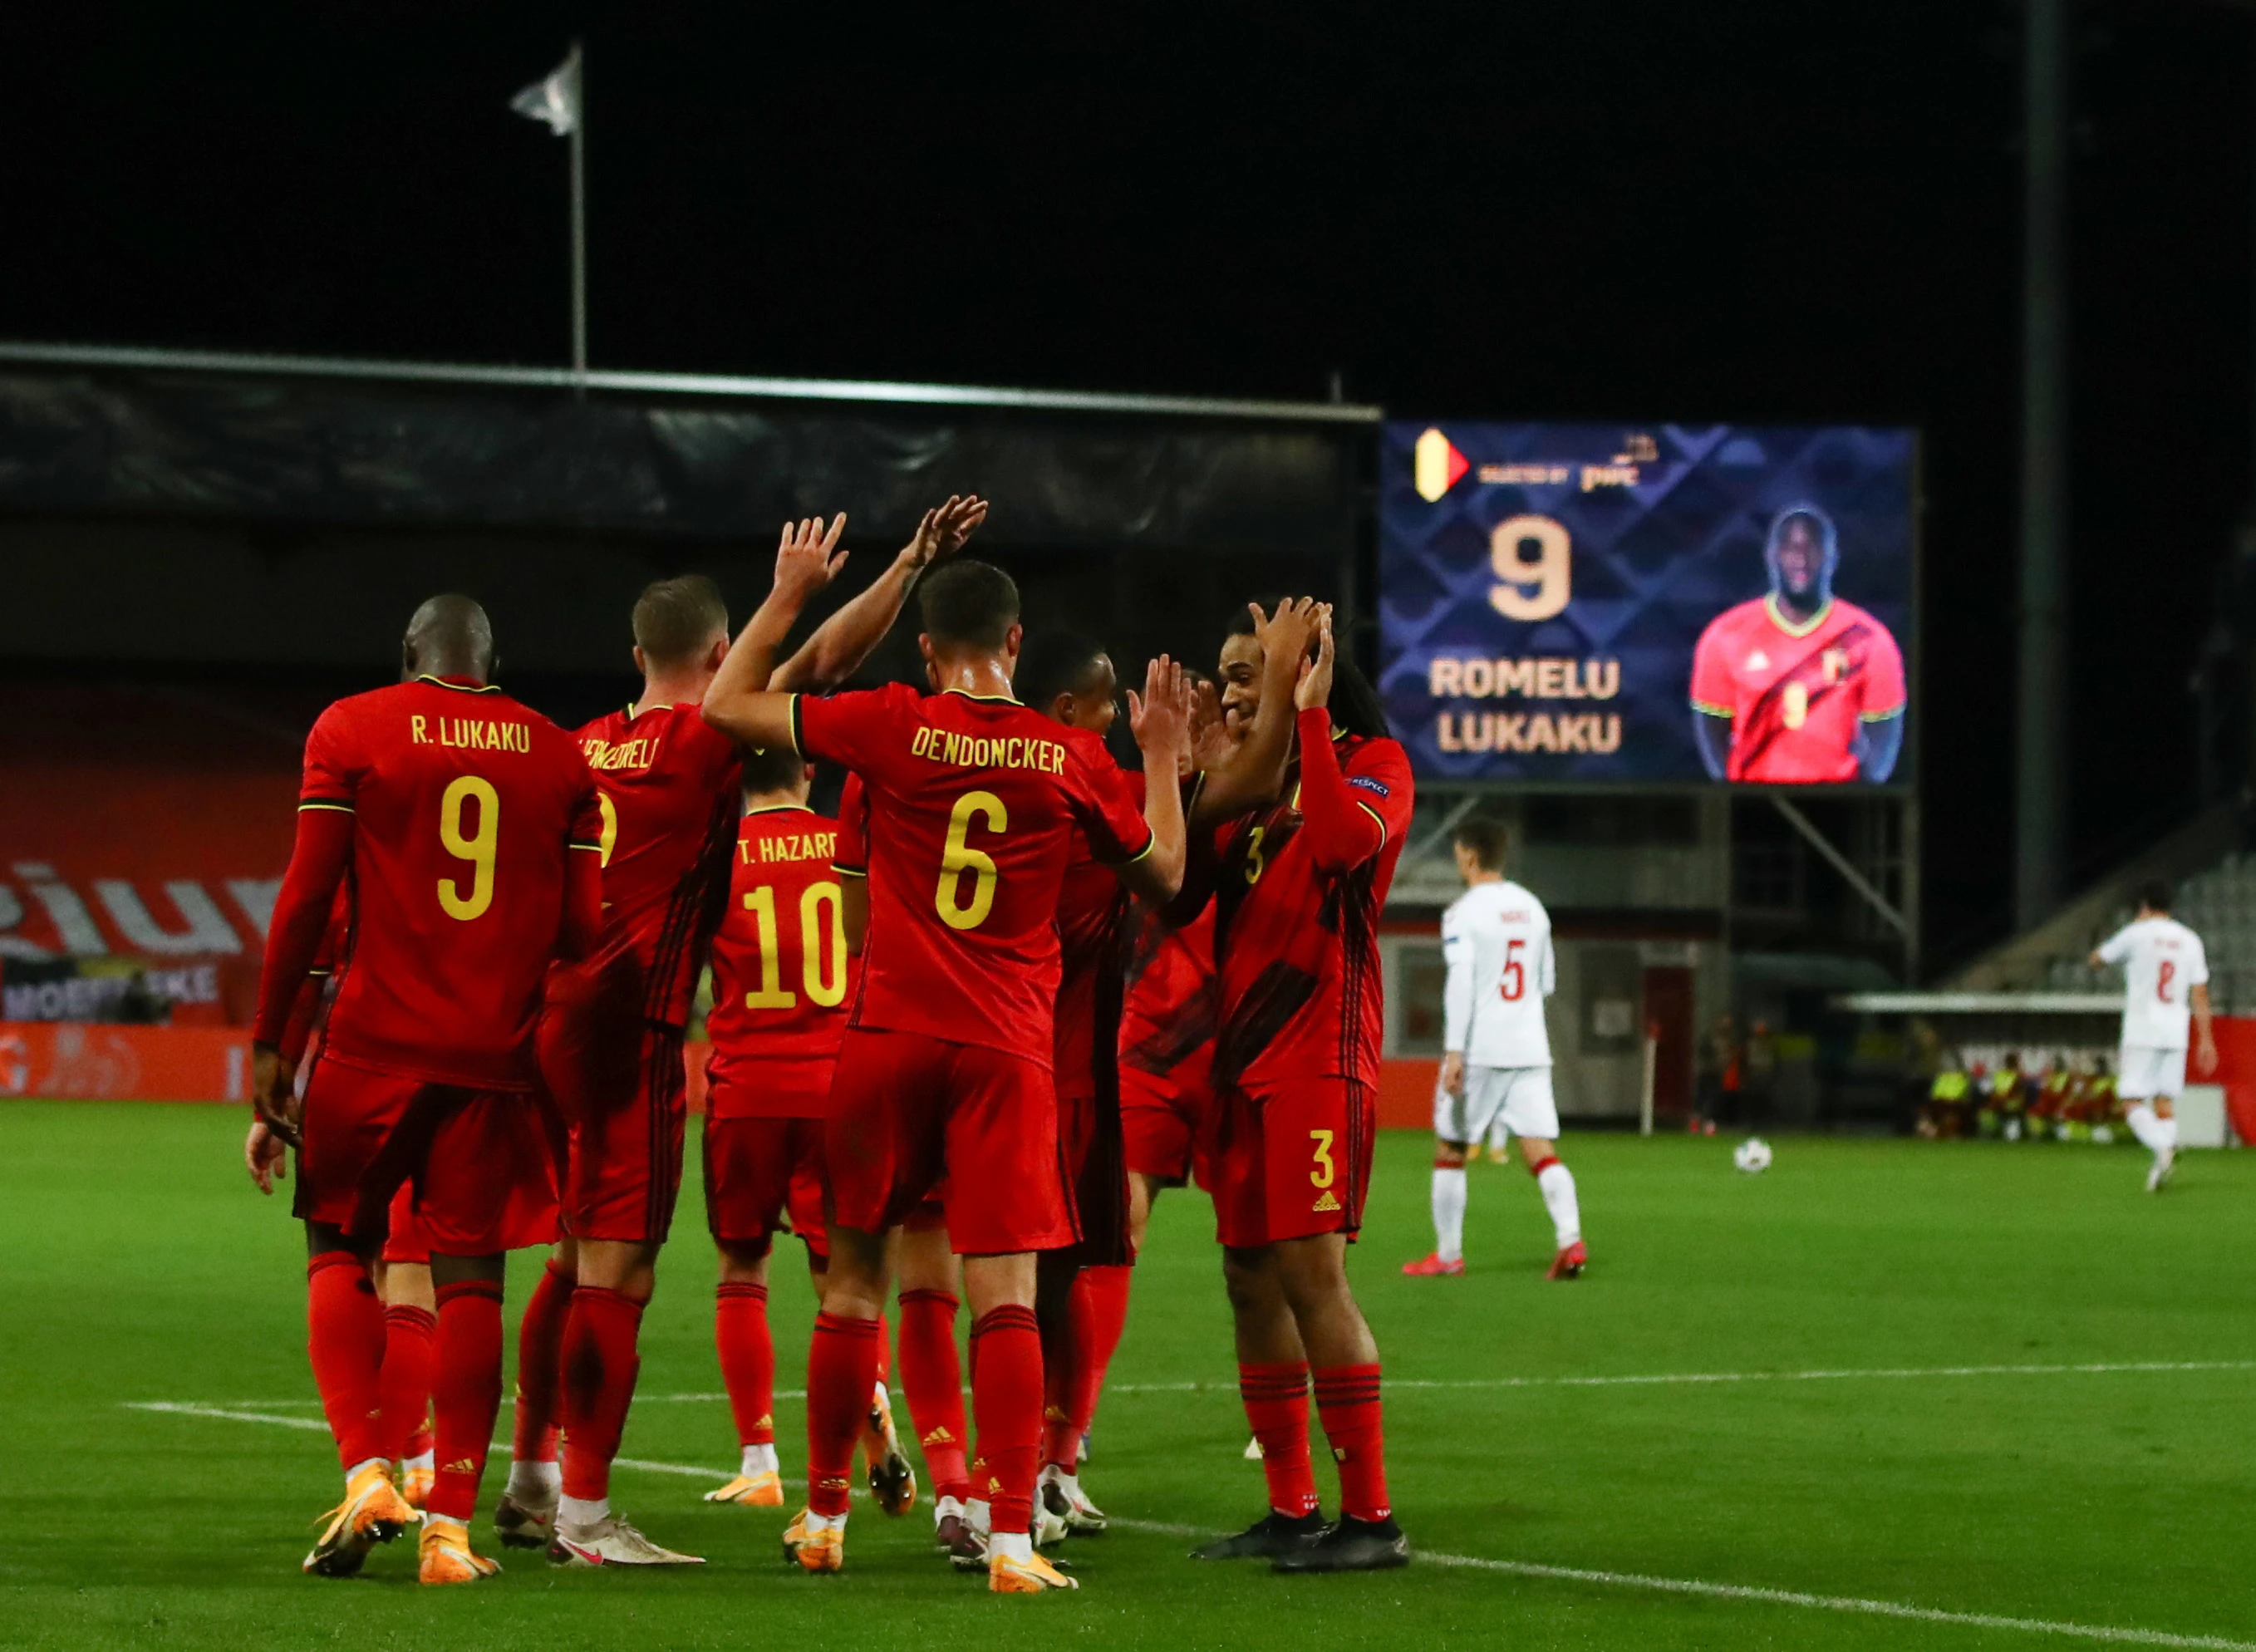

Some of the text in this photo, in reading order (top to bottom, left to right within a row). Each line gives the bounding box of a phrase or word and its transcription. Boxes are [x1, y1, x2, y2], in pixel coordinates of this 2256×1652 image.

[1489, 514, 1572, 622] 9
[1429, 657, 1621, 700] ROMELU
[411, 715, 530, 754] R. LUKAKU
[911, 726, 1065, 776] DENDONCKER
[1437, 712, 1622, 754] LUKAKU
[1352, 778, 1388, 795] RESPECT
[437, 775, 499, 921] 9
[737, 839, 756, 865] T.
[935, 790, 1008, 930] 6
[1246, 826, 1264, 885] 3
[743, 881, 848, 1009] 10
[1500, 939, 1526, 1002] 5
[1310, 1129, 1334, 1188] 3
